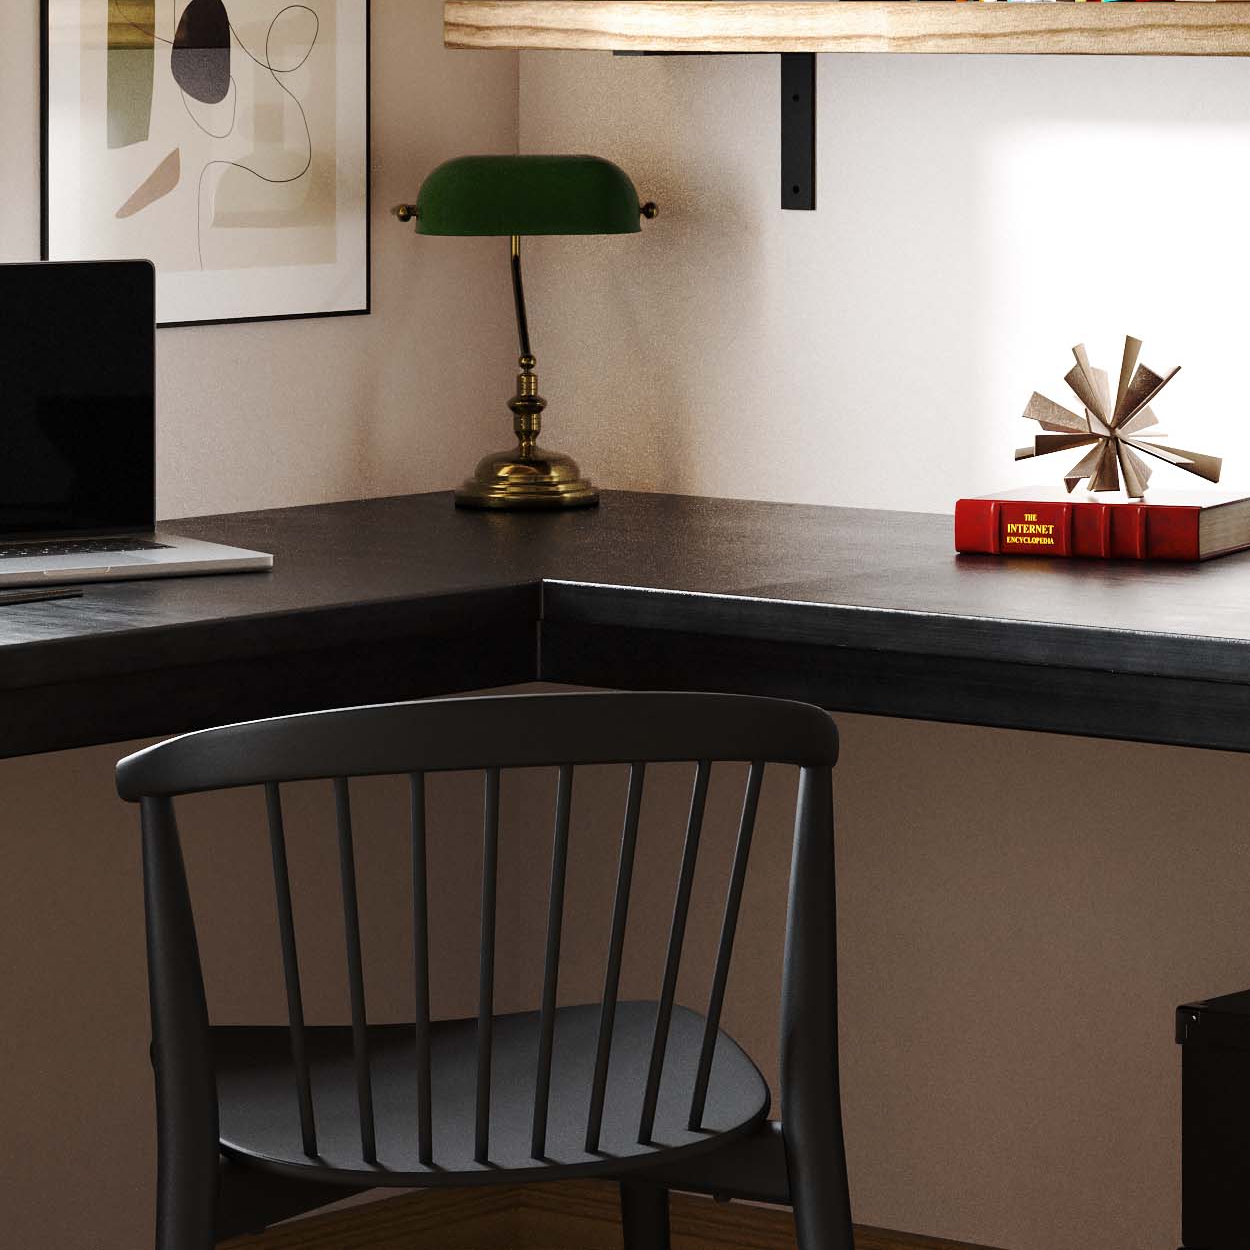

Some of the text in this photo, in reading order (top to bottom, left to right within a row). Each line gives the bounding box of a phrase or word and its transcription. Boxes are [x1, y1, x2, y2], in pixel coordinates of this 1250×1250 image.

[1024, 514, 1038, 522] THE
[1007, 524, 1055, 535] INTERNET
[1006, 536, 1054, 544] ENCYCLOPEDIA
